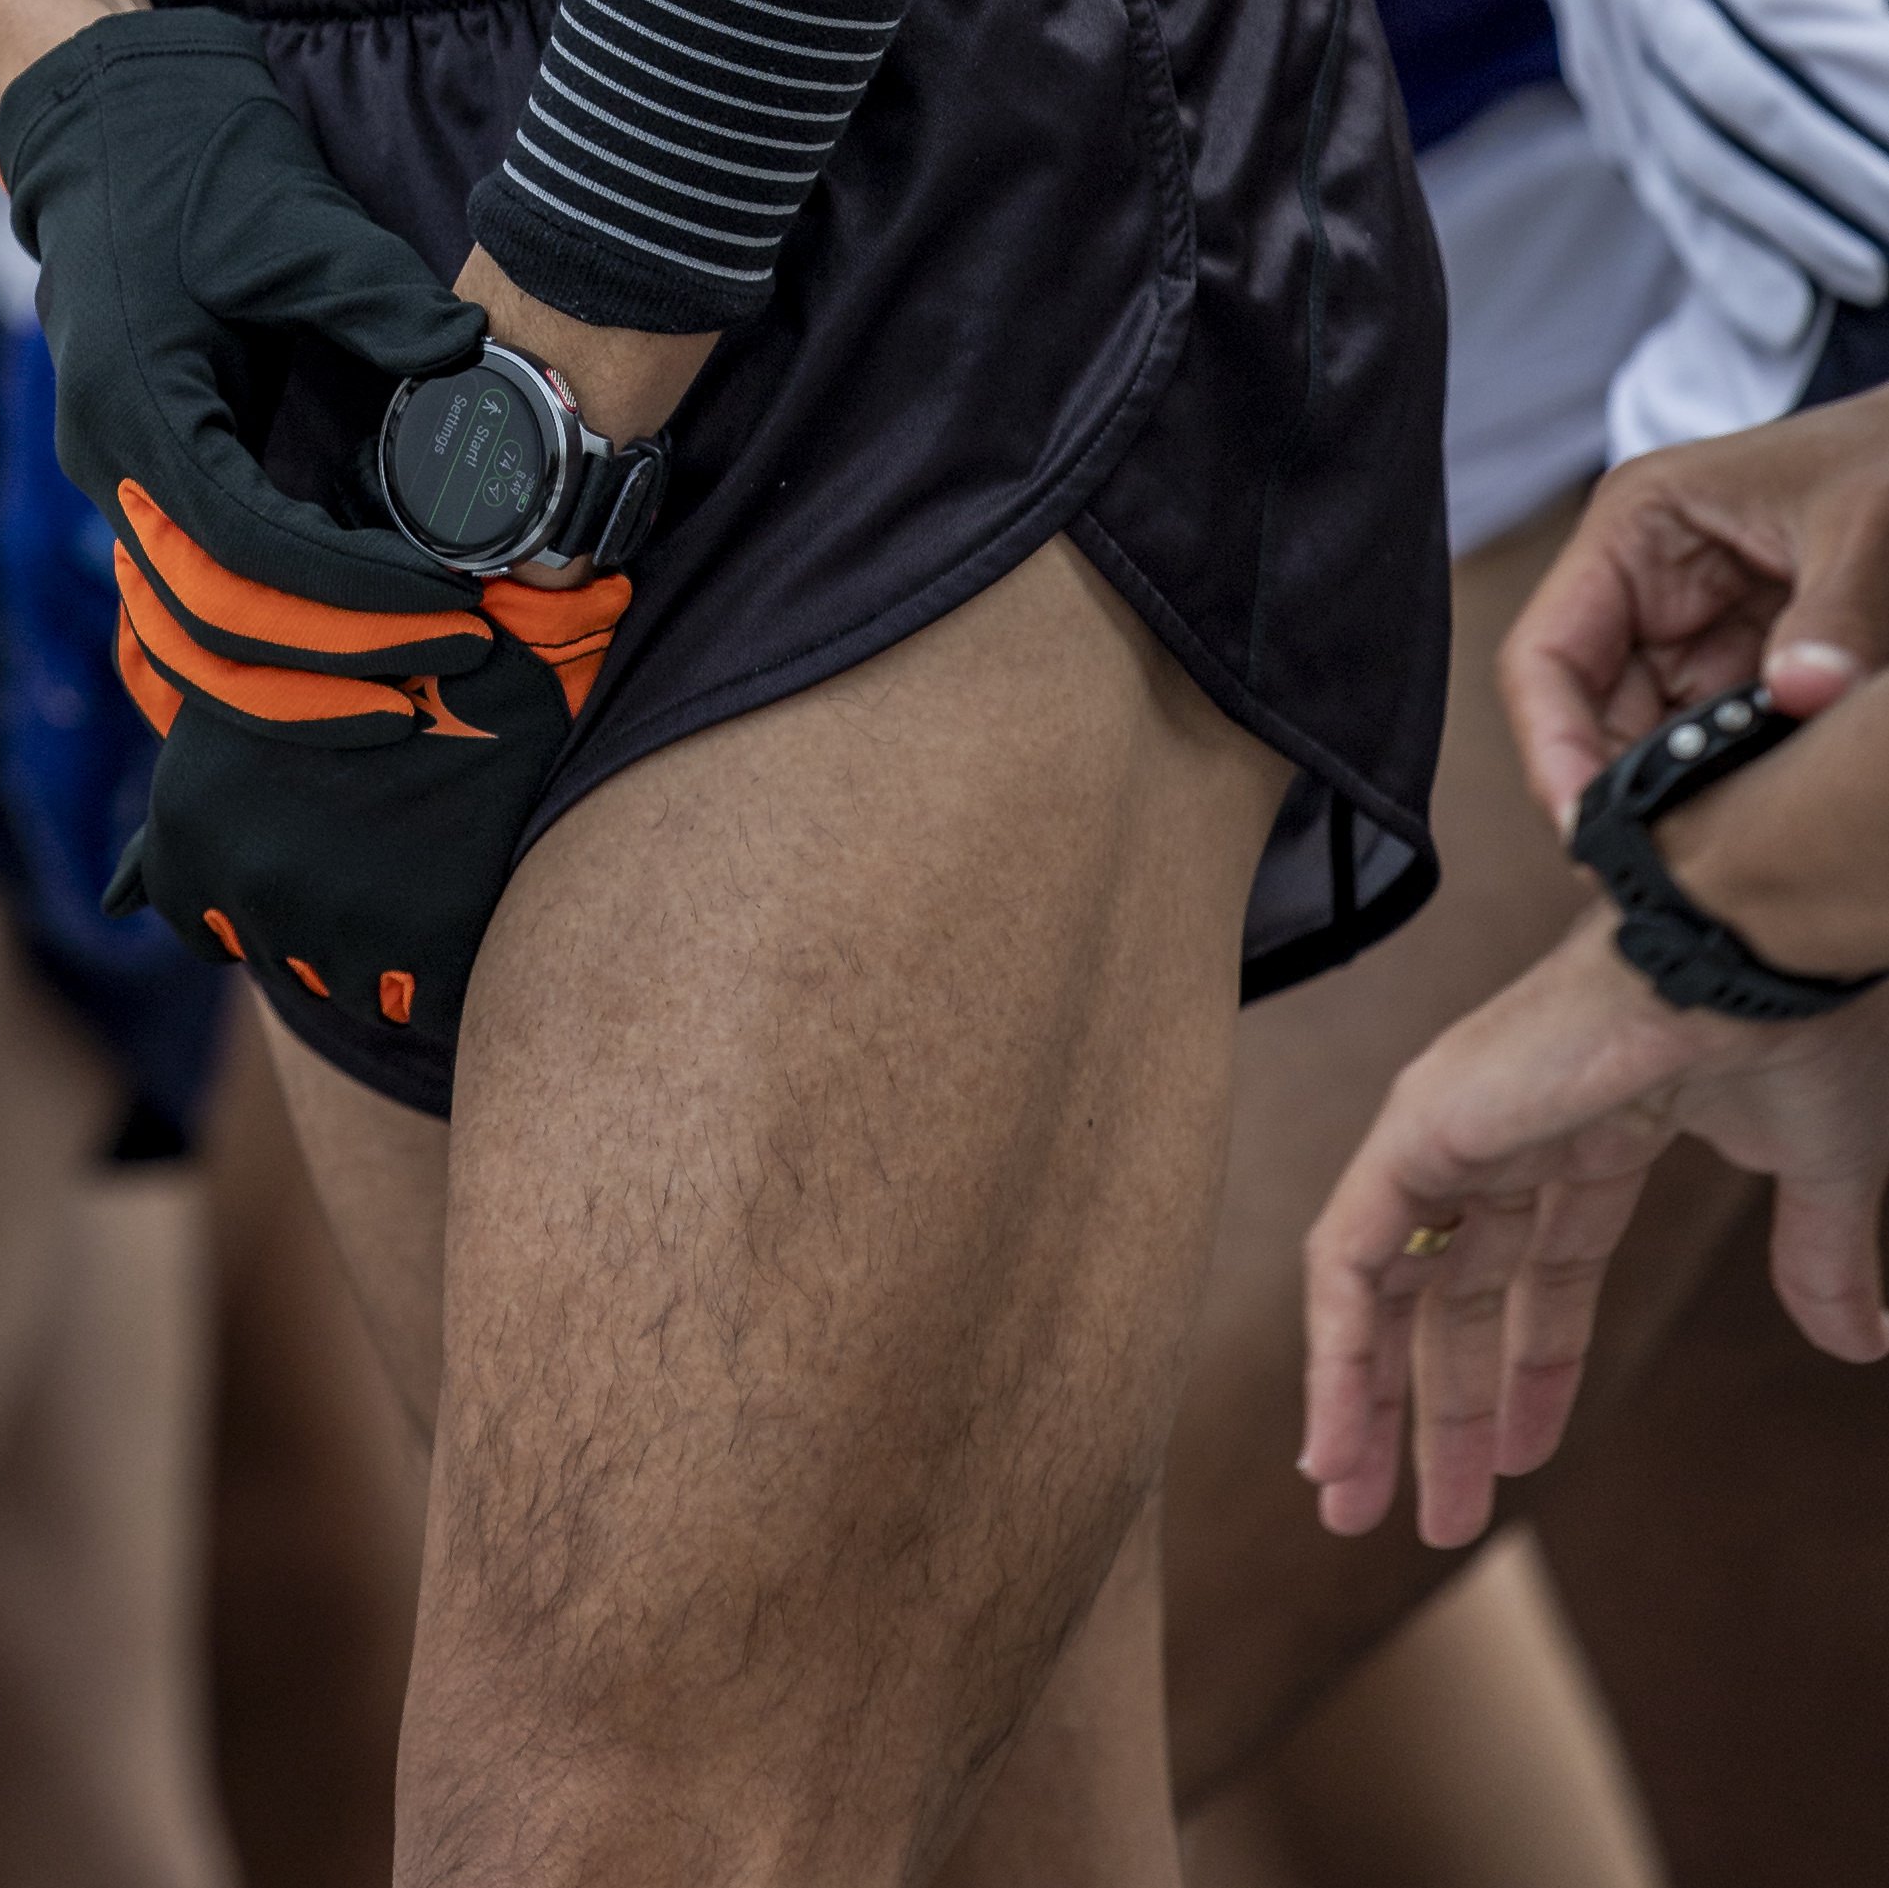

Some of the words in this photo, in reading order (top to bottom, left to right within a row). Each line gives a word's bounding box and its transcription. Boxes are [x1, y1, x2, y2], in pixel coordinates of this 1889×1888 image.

[434, 394, 468, 455] Settings
[465, 425, 490, 468] Start!
[499, 449, 517, 471] 74
[510, 470, 526, 496] 8:49
